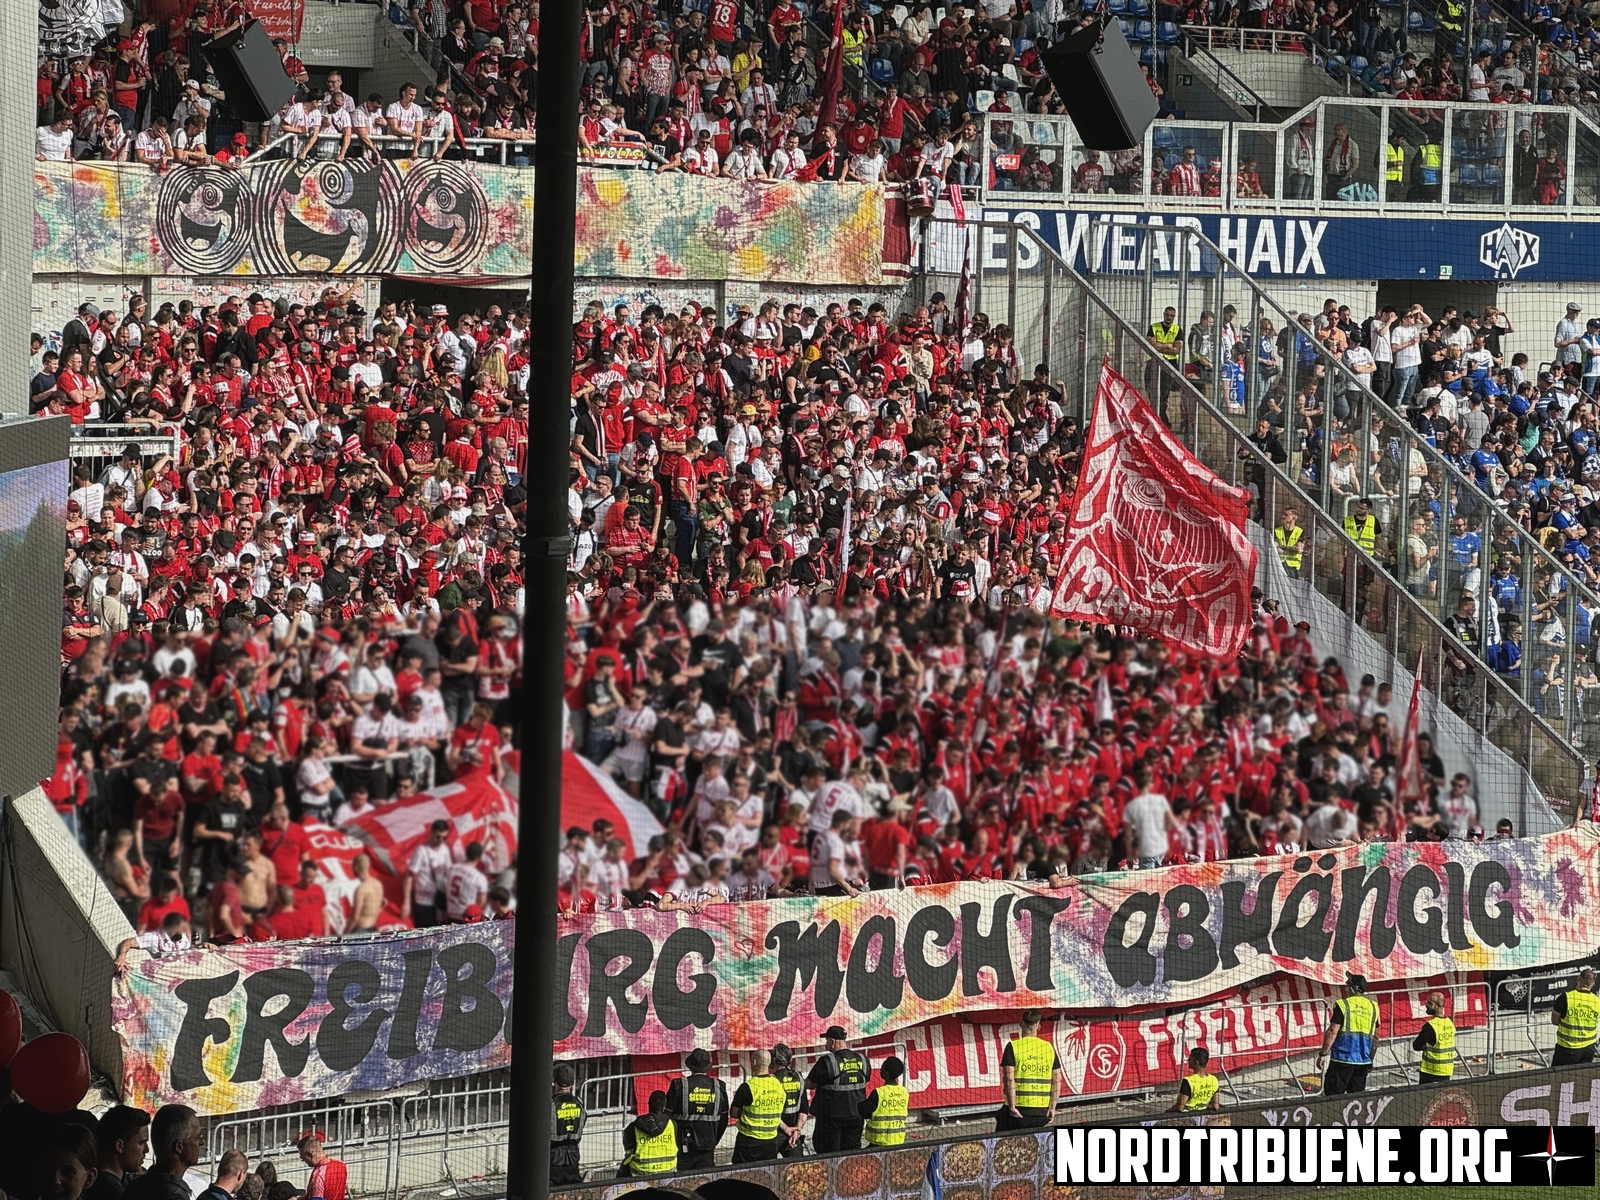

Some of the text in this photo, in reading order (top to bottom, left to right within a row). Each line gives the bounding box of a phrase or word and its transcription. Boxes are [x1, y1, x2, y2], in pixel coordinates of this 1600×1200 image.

[714, 4, 731, 23] 18
[599, 147, 641, 160] VOLTS
[1055, 212, 1202, 277] WEAR
[1219, 217, 1329, 275] HAIX
[1567, 1008, 1599, 1020] ORDNER
[1021, 1063, 1051, 1073] ORDNER
[689, 1093, 716, 1103] SECURITY
[755, 1097, 784, 1108] ORDNER
[639, 1134, 673, 1146] ORDNER
